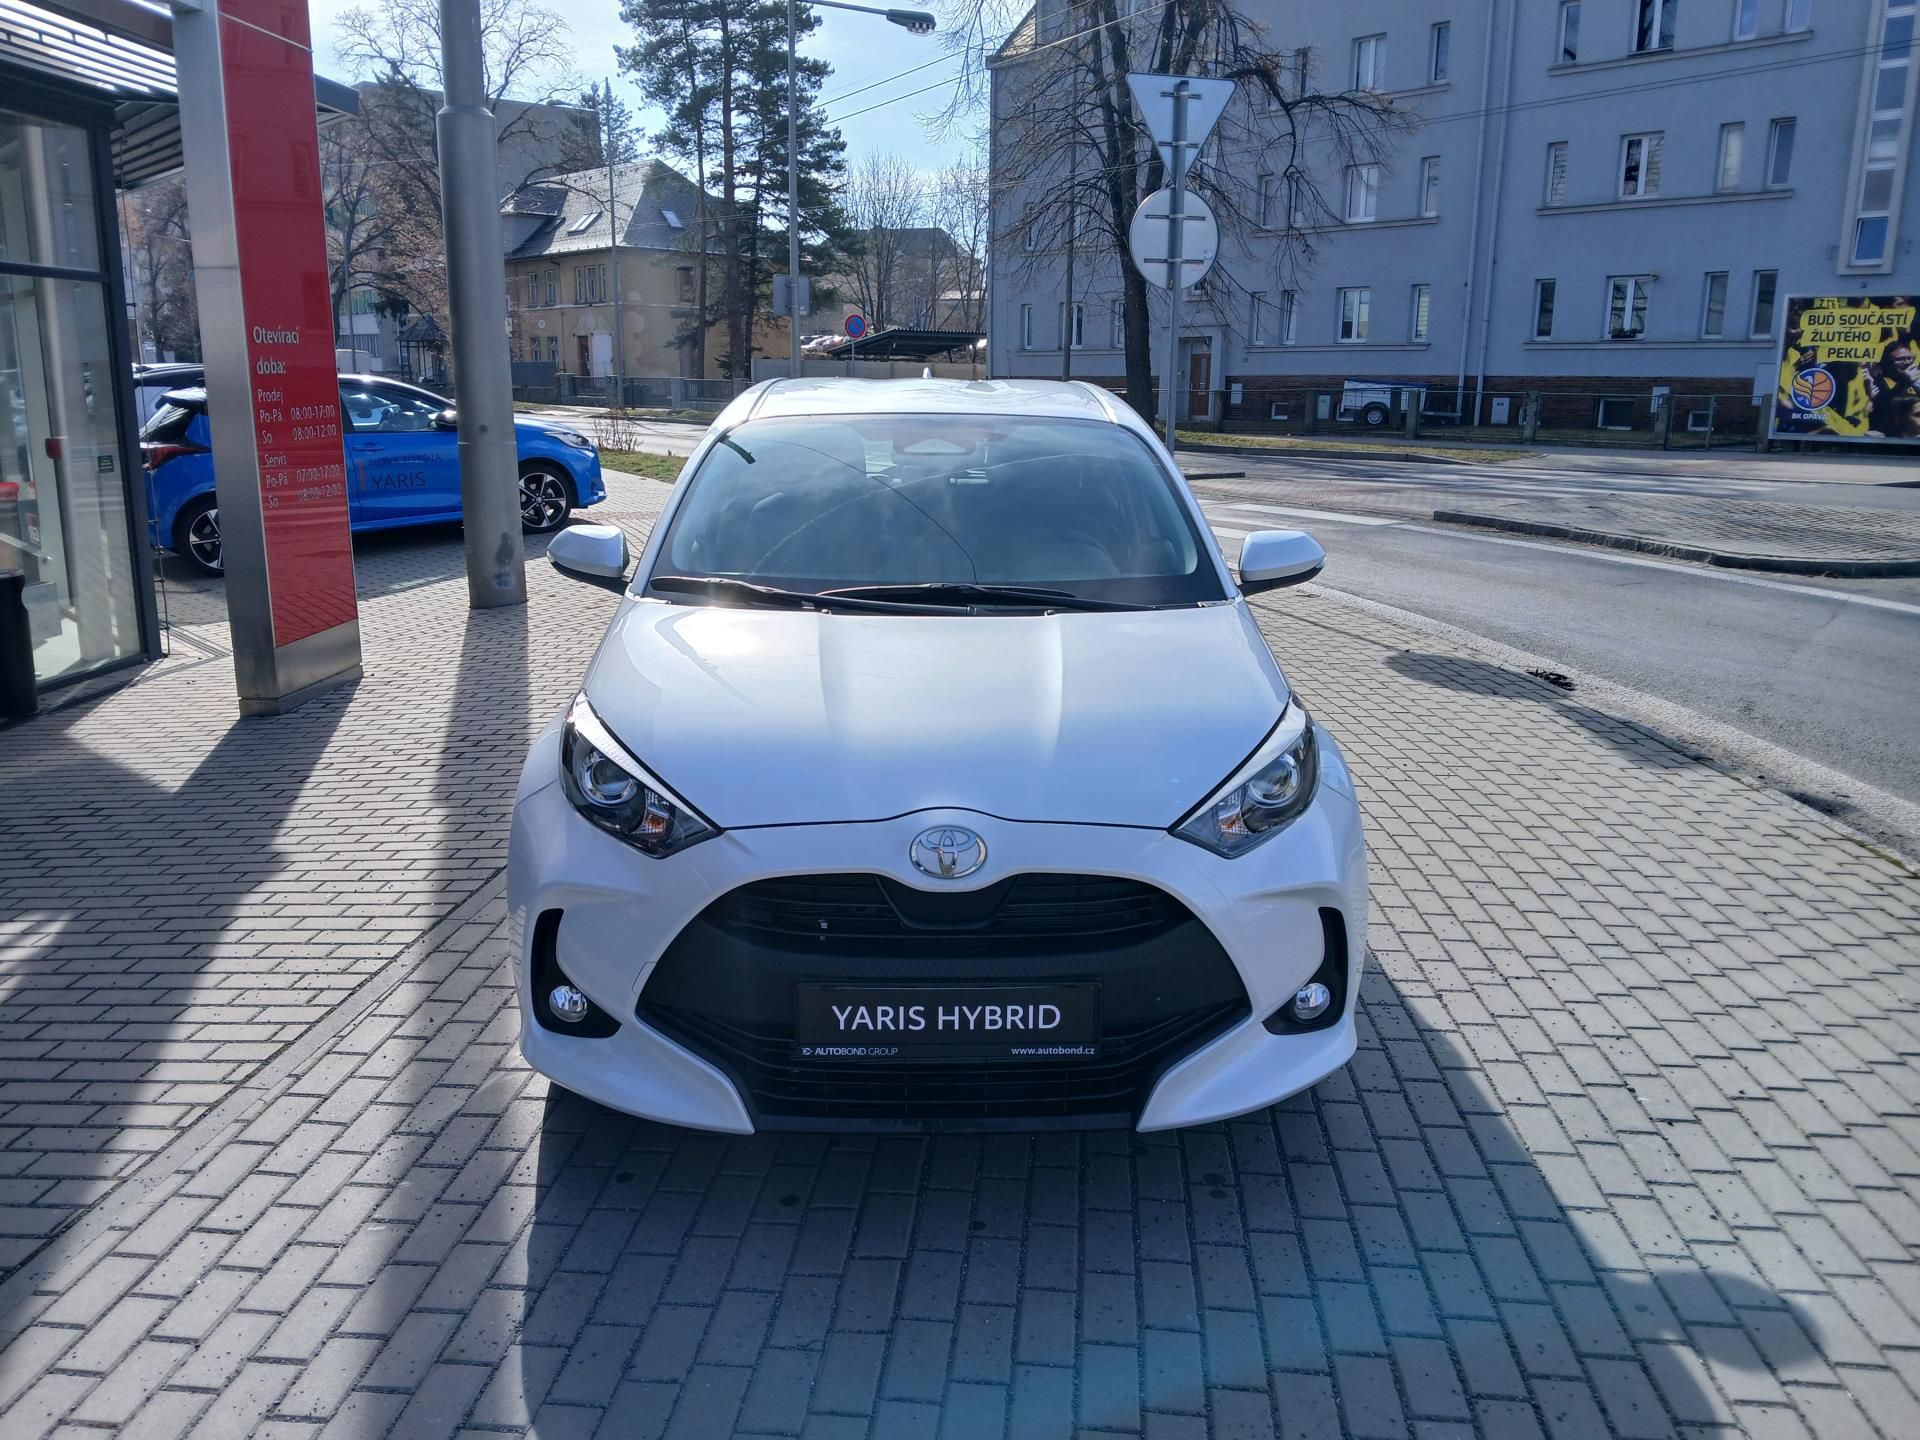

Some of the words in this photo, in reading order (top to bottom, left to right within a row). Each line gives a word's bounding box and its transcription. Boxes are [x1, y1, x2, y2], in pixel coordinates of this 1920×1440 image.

[1807, 311, 1835, 326] BUĎ
[1839, 310, 1908, 326] SOUČÁSTÍ
[253, 325, 300, 344] Otevírací
[1810, 328, 1872, 343] ŽLUTÉHO
[1827, 347, 1876, 359] PEKLA!
[256, 356, 287, 374] doba:
[257, 387, 284, 406] Prodej
[260, 408, 283, 423] Po-Pá
[290, 404, 335, 421] 08:00-17:00
[1791, 412, 1802, 420] BK
[262, 430, 273, 444] So
[292, 423, 337, 441] 08:00-12:00
[264, 452, 288, 468] Servis
[266, 472, 289, 488] Po-Pá
[296, 464, 341, 482] 07:00-17:00
[371, 471, 427, 490] YARIS
[268, 495, 280, 509] So
[831, 1005, 926, 1031] YARIS
[937, 1004, 1061, 1031] HYBRID
[814, 1047, 867, 1056] AUTOBOND
[868, 1047, 899, 1056] GROUP
[1011, 1046, 1096, 1056] www.autobond.cz
